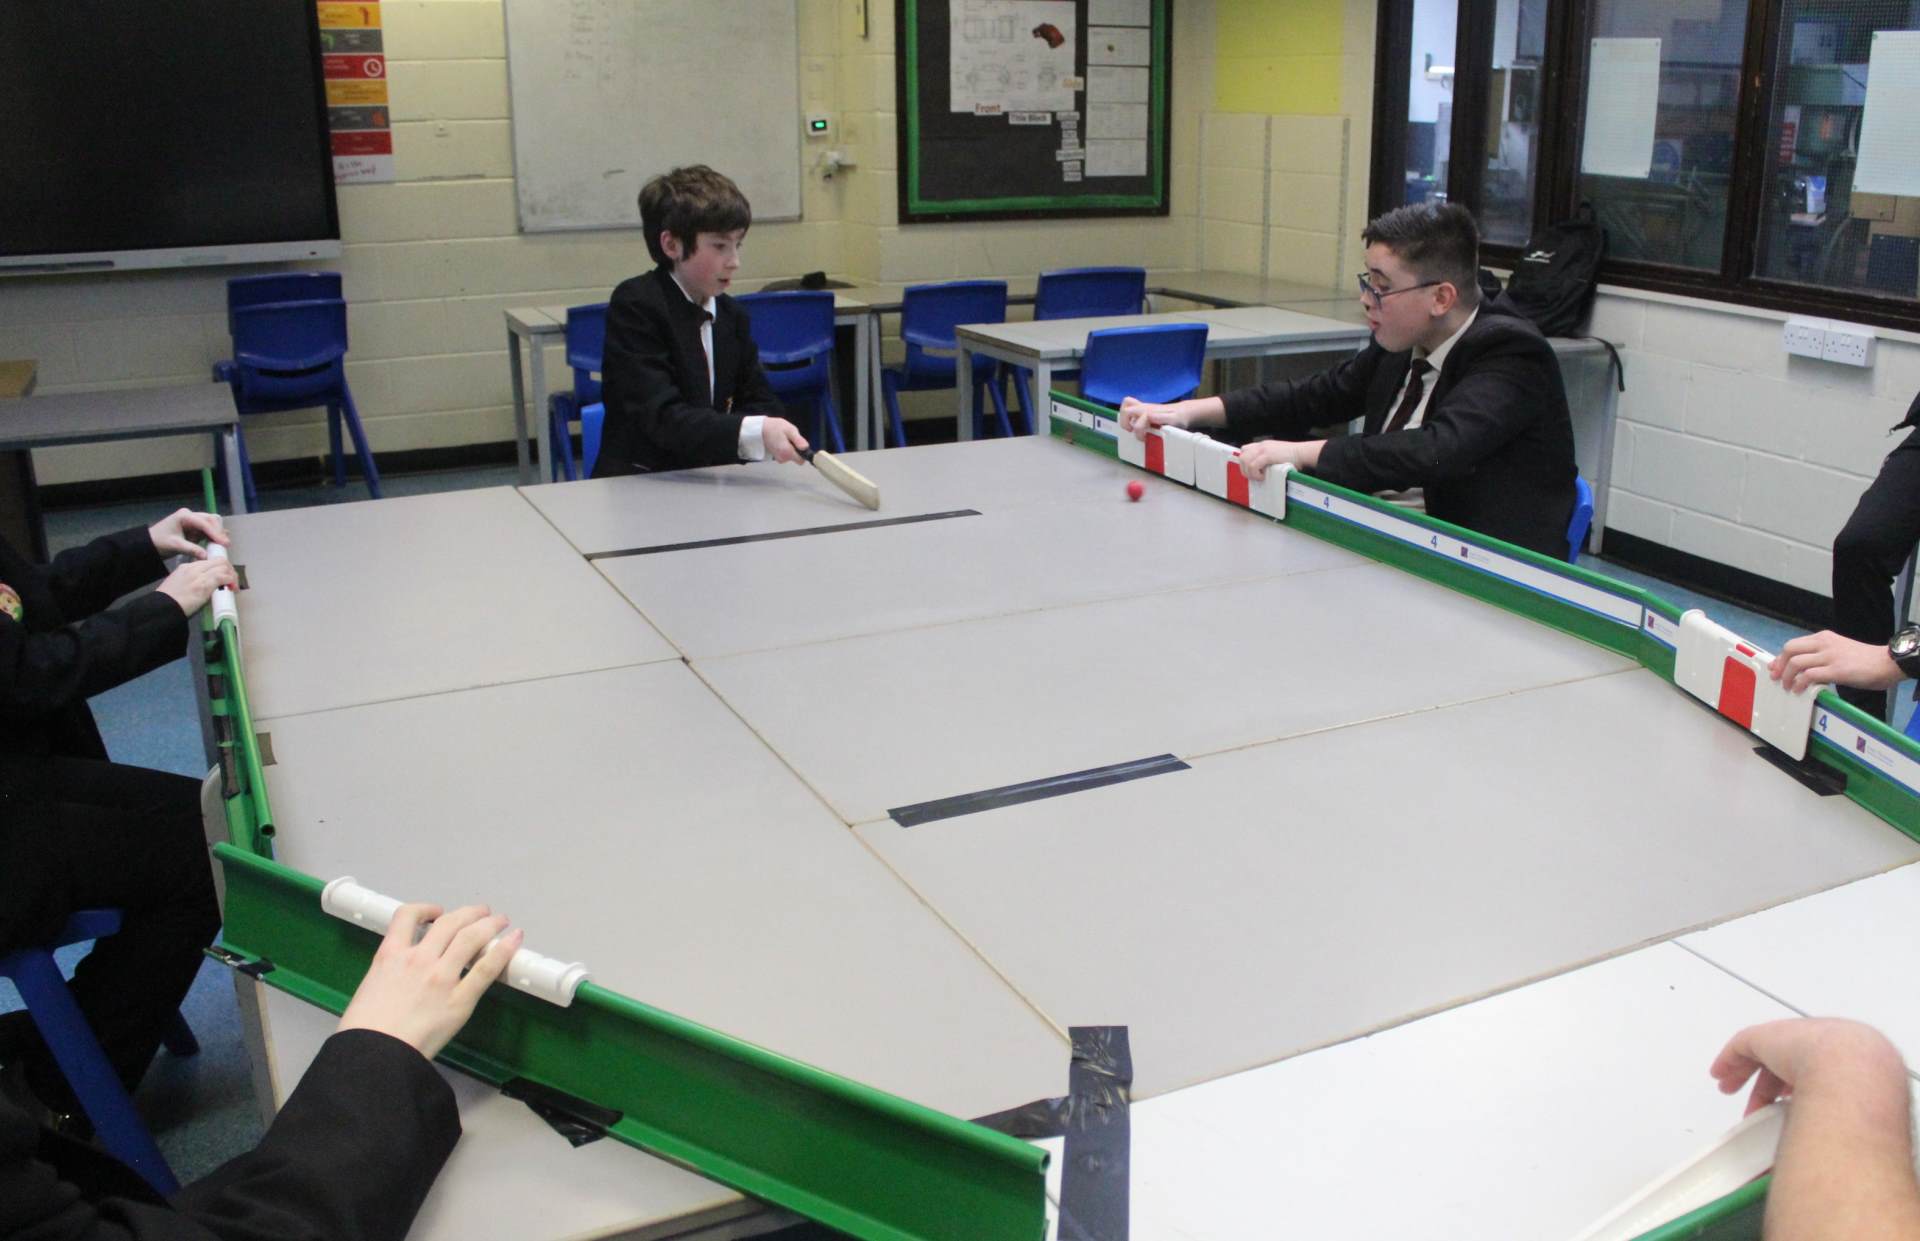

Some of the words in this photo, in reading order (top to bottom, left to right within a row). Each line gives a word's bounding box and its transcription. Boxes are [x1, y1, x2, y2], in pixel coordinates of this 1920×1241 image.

[975, 102, 1001, 113] Front
[1323, 496, 1329, 508] 4
[1430, 535, 1438, 549] 4
[1818, 714, 1828, 732] 4
